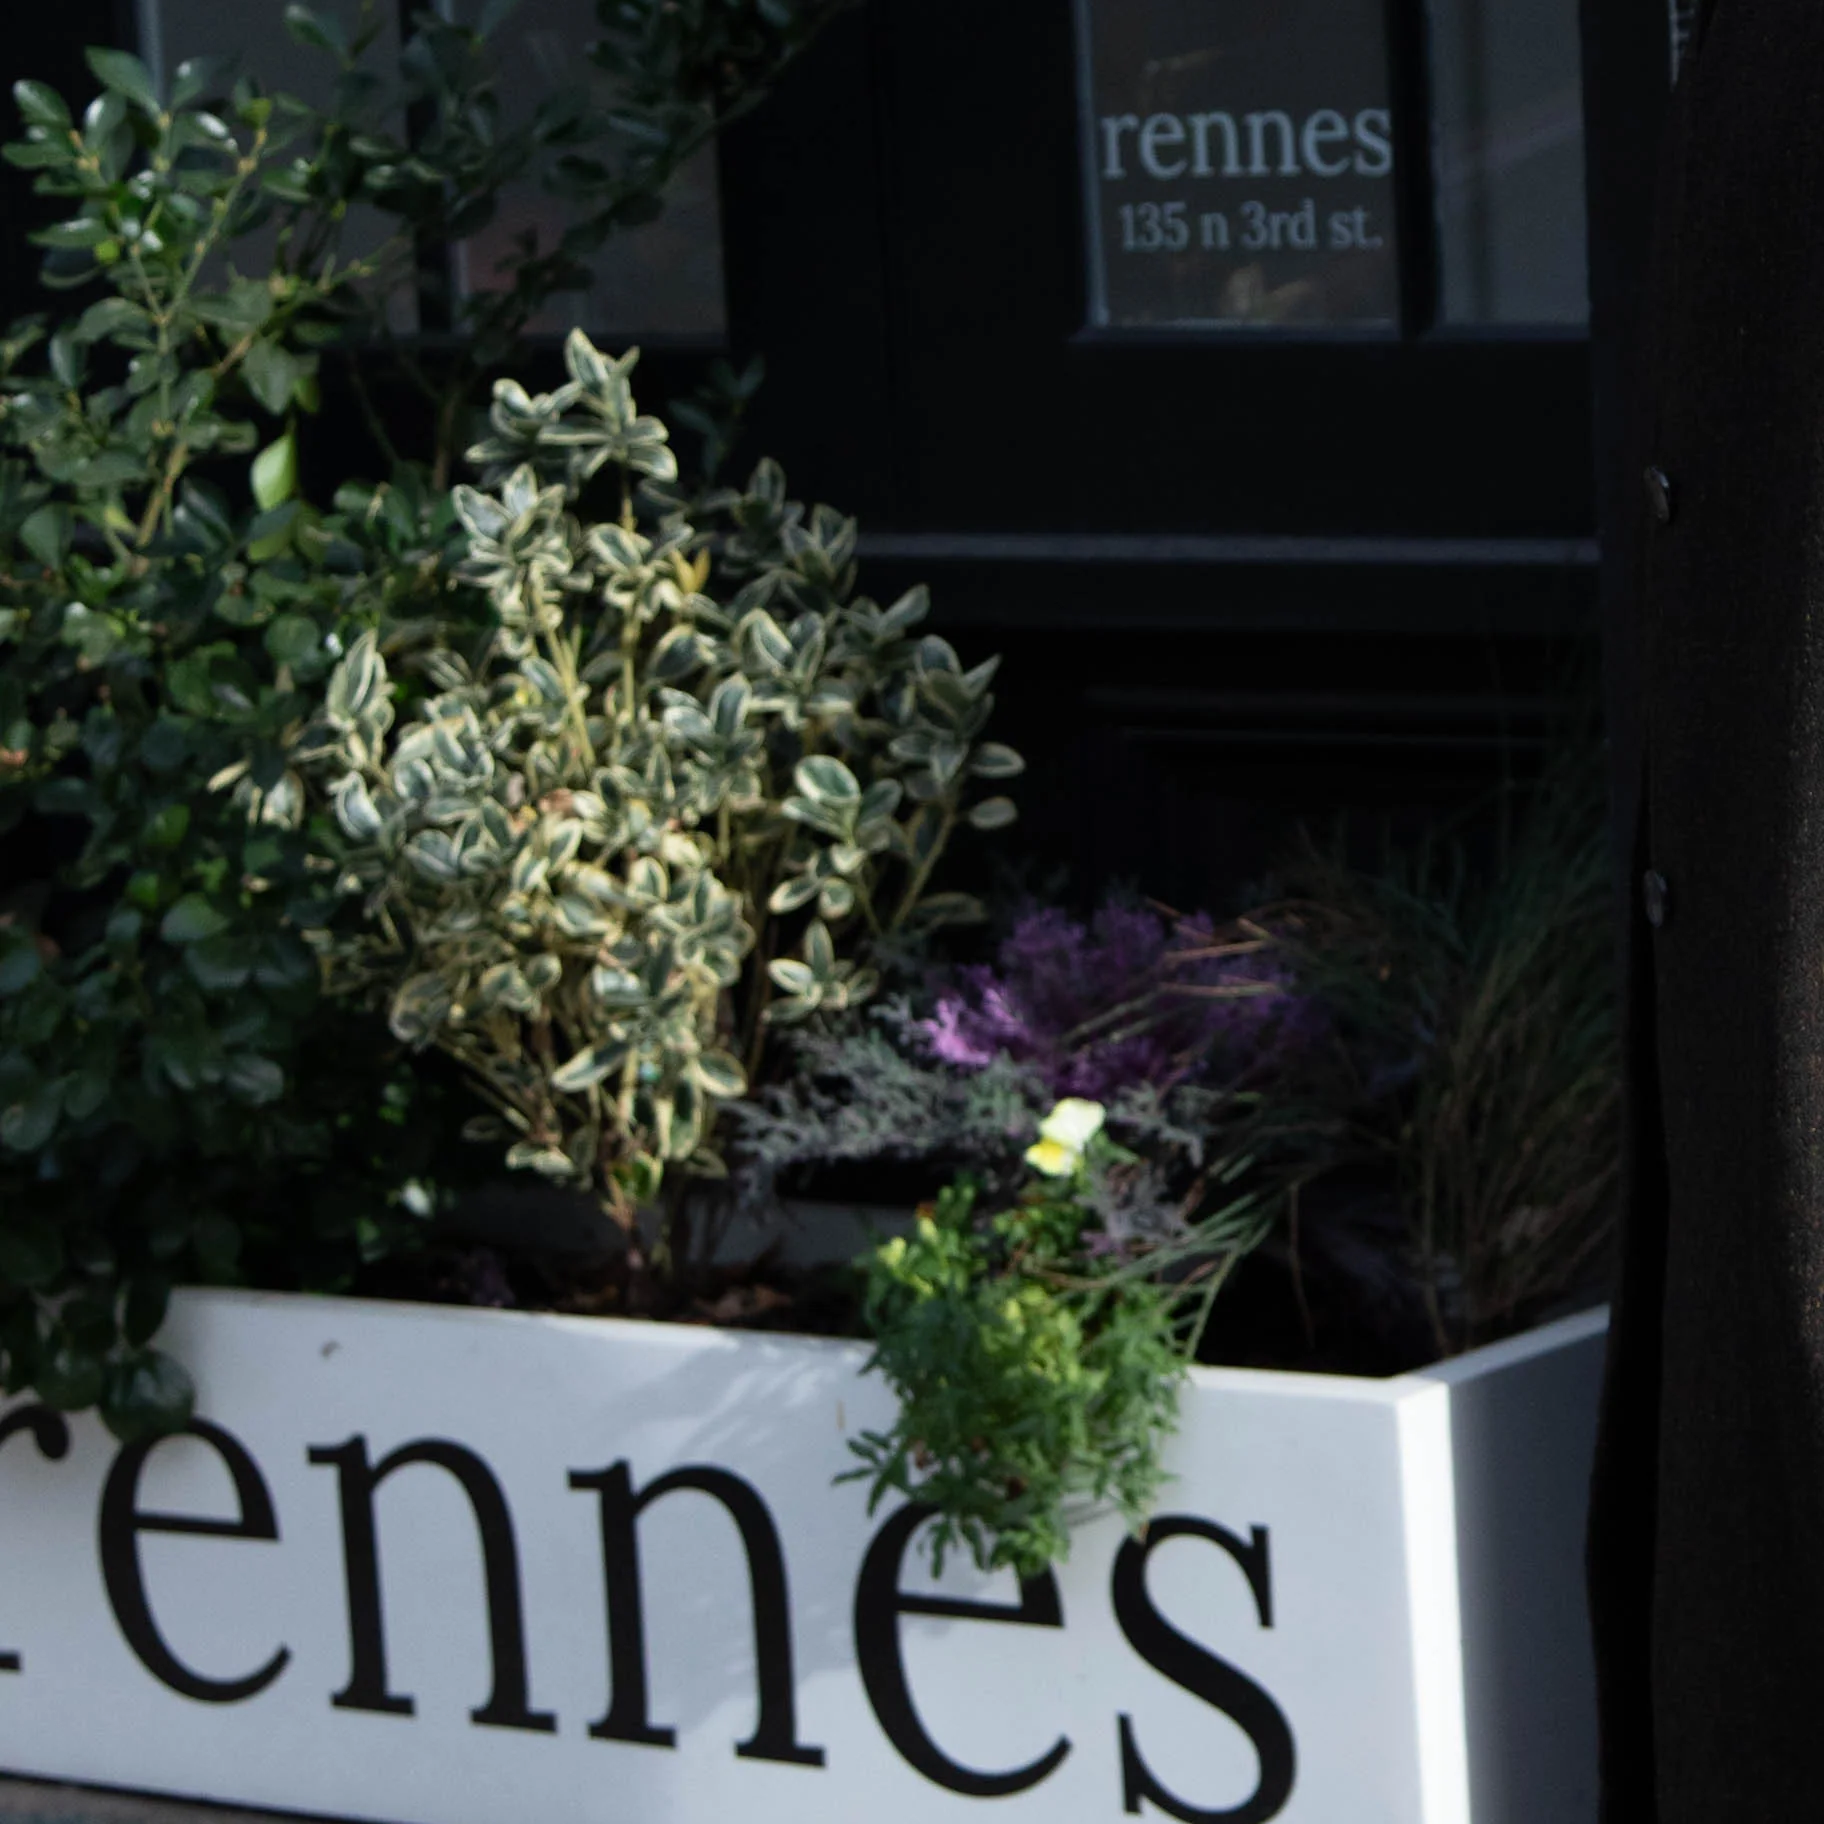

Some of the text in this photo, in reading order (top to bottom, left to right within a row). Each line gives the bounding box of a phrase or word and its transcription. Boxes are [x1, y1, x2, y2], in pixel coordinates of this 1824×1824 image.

[1100, 107, 1393, 180] rennes
[1119, 197, 1384, 253] 135 n 3rd st.
